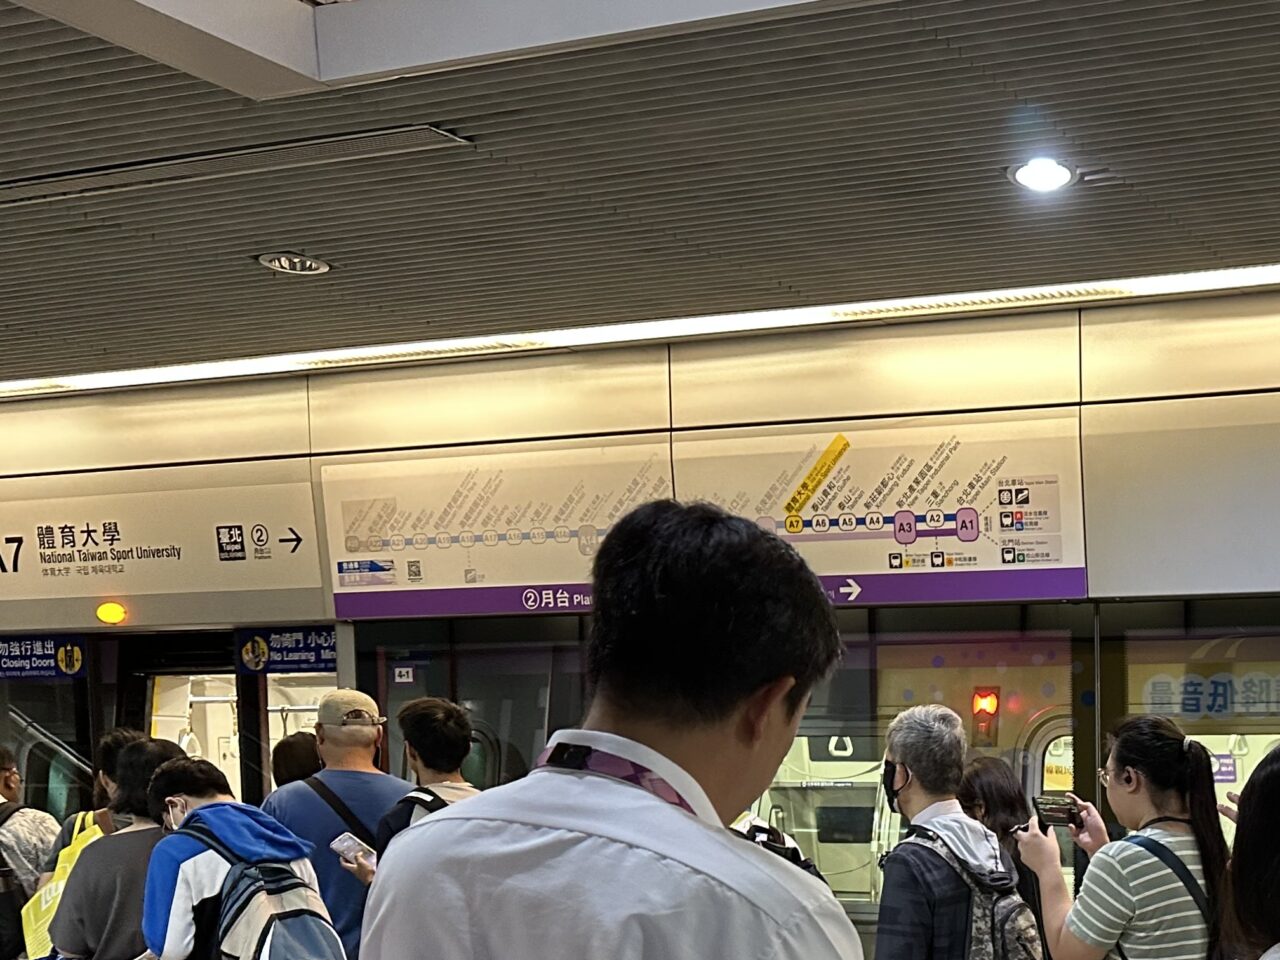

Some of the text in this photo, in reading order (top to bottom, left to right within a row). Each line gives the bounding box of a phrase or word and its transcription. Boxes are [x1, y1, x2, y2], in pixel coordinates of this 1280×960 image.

[917, 478, 931, 494] Taipei
[948, 439, 960, 453] Park
[967, 455, 1006, 505] Taipei Main Station
[935, 479, 958, 507] Sanchong
[955, 473, 982, 505] 台北車站
[924, 490, 940, 507] 三重
[789, 520, 800, 529] A7
[815, 519, 827, 527] A6
[842, 518, 853, 526] A5
[869, 517, 880, 525] A4
[929, 515, 941, 523] A2
[898, 523, 912, 533] A3
[960, 520, 974, 530] A1
[37, 522, 121, 550] 體育大學
[39, 545, 181, 564] National Taiwan Sport University
[1, 657, 55, 669] Closing Doors
[397, 670, 410, 679] 4-1
